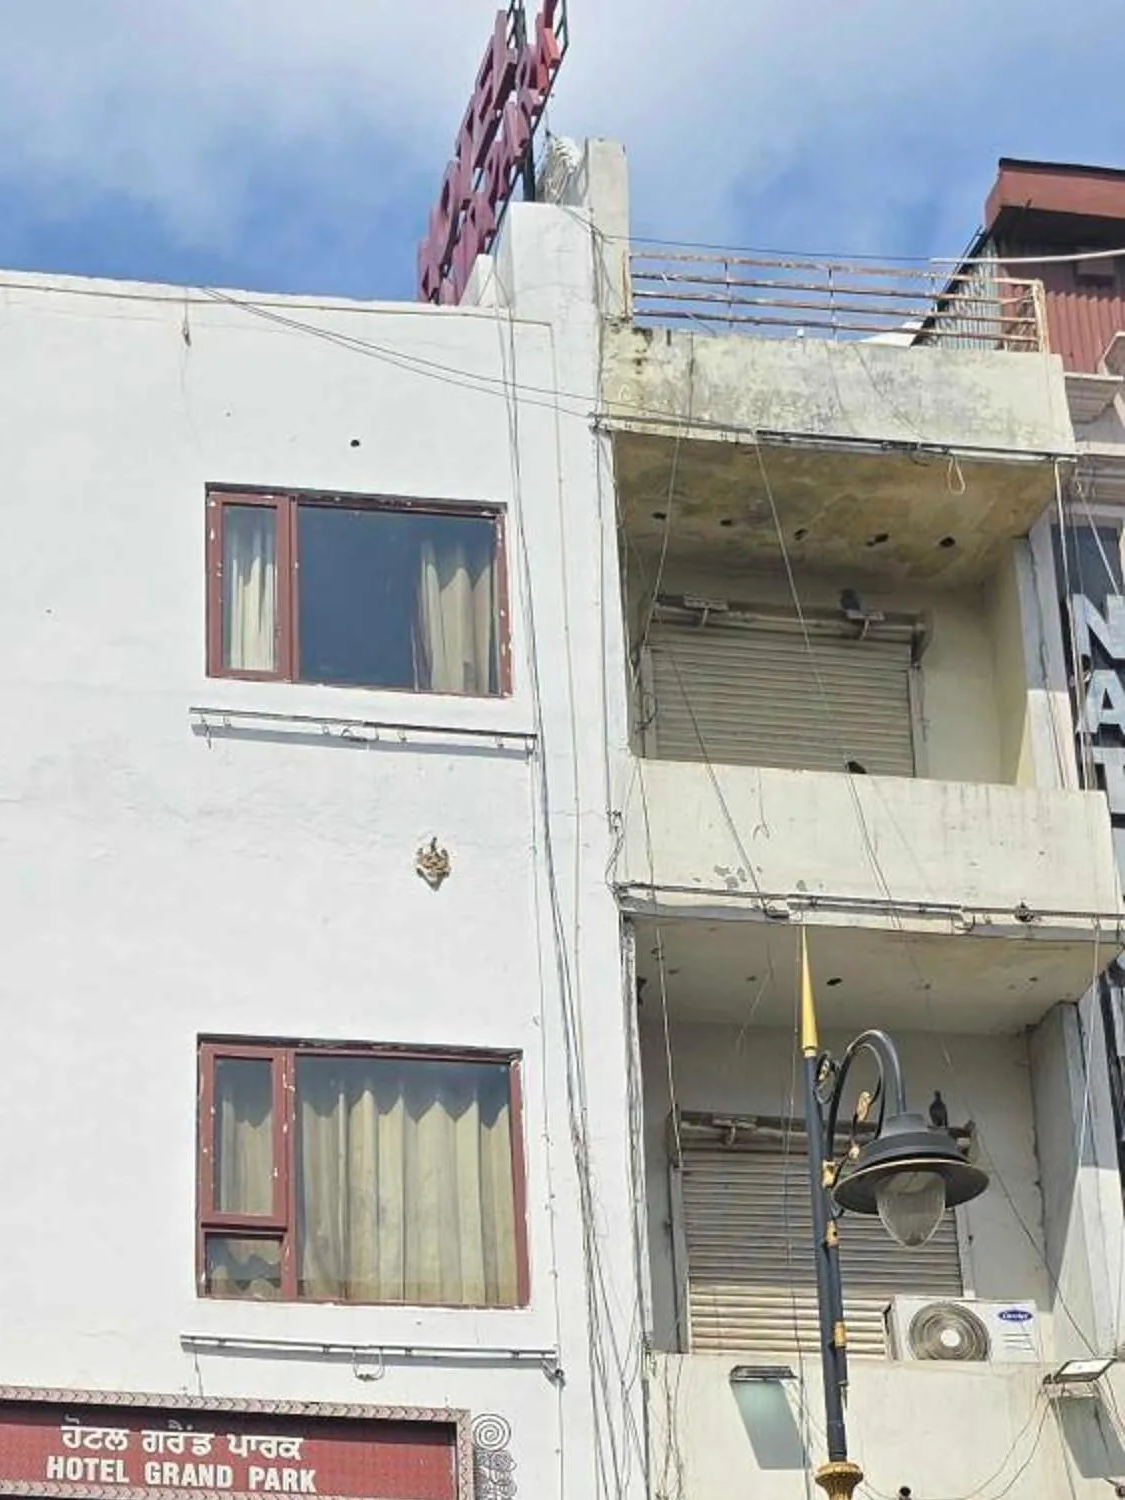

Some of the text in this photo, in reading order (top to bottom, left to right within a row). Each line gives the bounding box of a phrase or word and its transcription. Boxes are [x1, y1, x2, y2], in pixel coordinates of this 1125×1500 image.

[60, 1413, 129, 1451] ਹੋਟਲ
[227, 1434, 304, 1461] ਪਾਰਕ
[47, 1456, 316, 1493] HOTEL GRAND PARK
